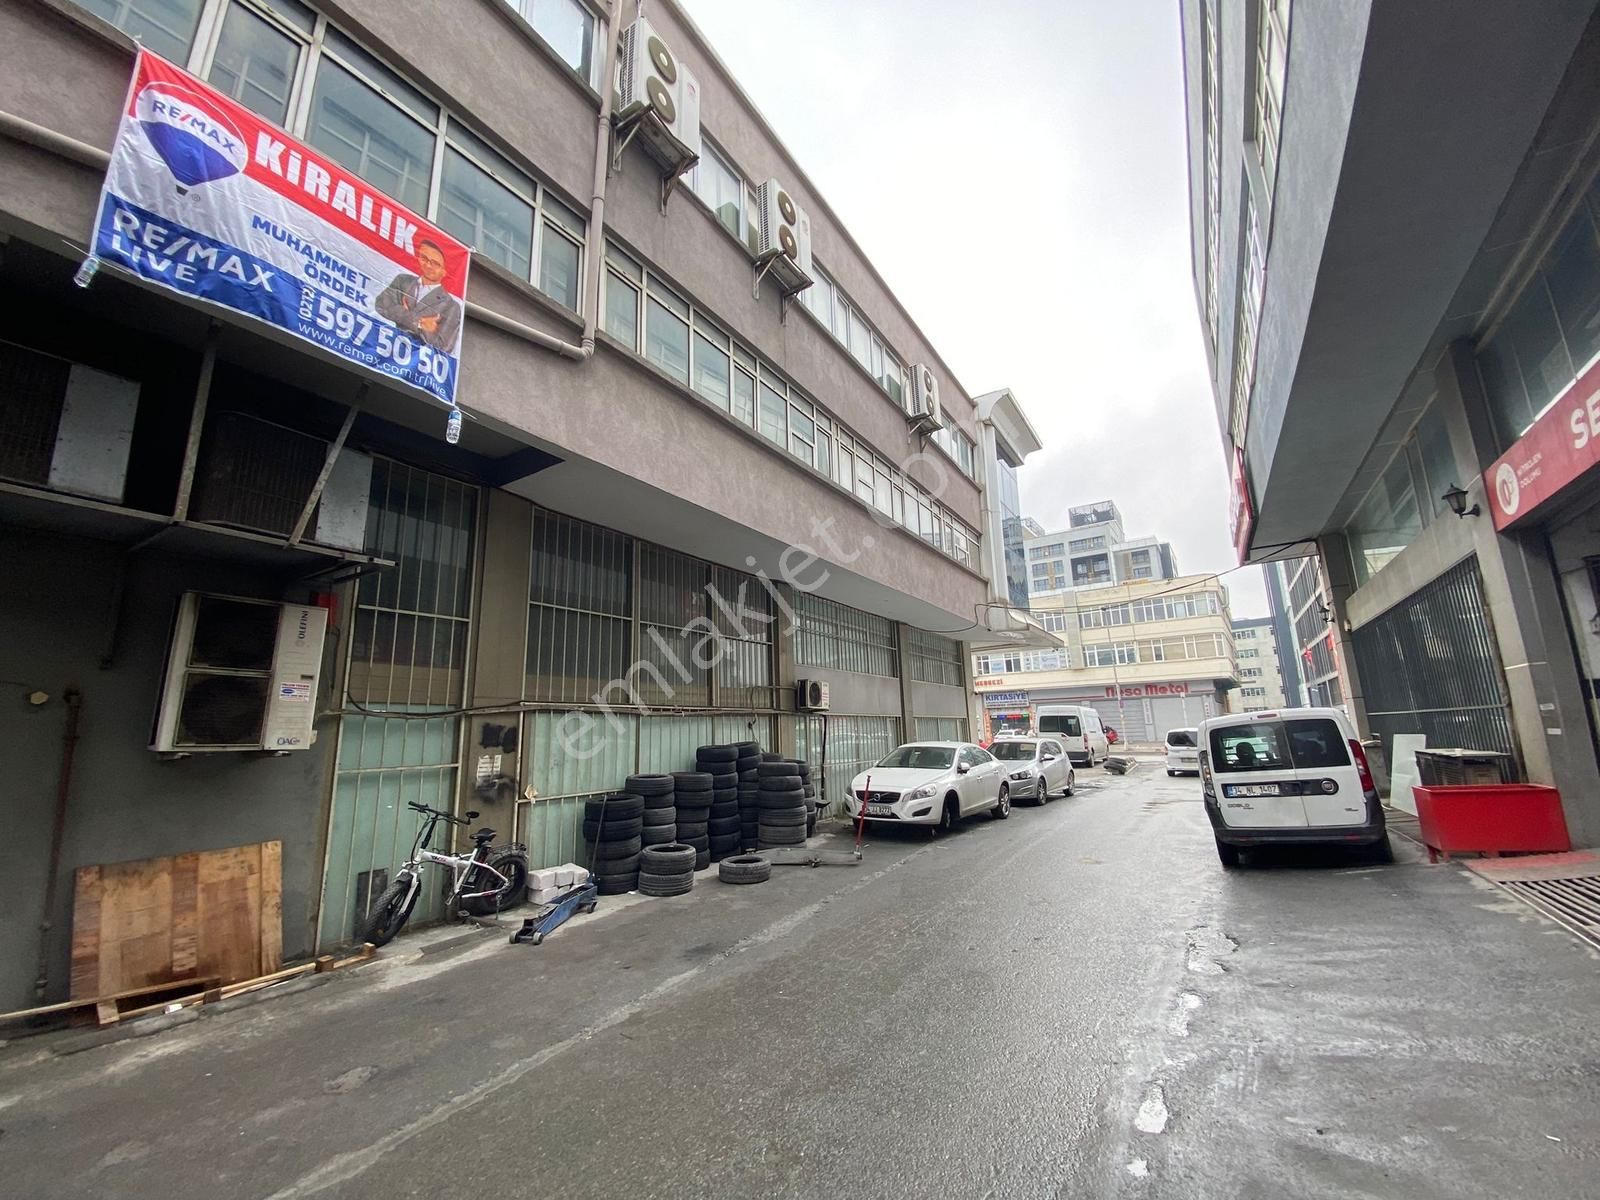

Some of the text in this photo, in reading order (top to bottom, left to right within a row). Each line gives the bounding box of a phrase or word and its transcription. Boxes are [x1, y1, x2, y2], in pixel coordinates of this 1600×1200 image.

[152, 100, 235, 154] RE/MAX
[112, 235, 198, 284] LIVE
[113, 208, 274, 292] RE/MAX
[252, 214, 370, 289] MUHAMMET
[304, 262, 369, 307] ÖRDEK
[298, 285, 449, 384] (0212) 597 50 50
